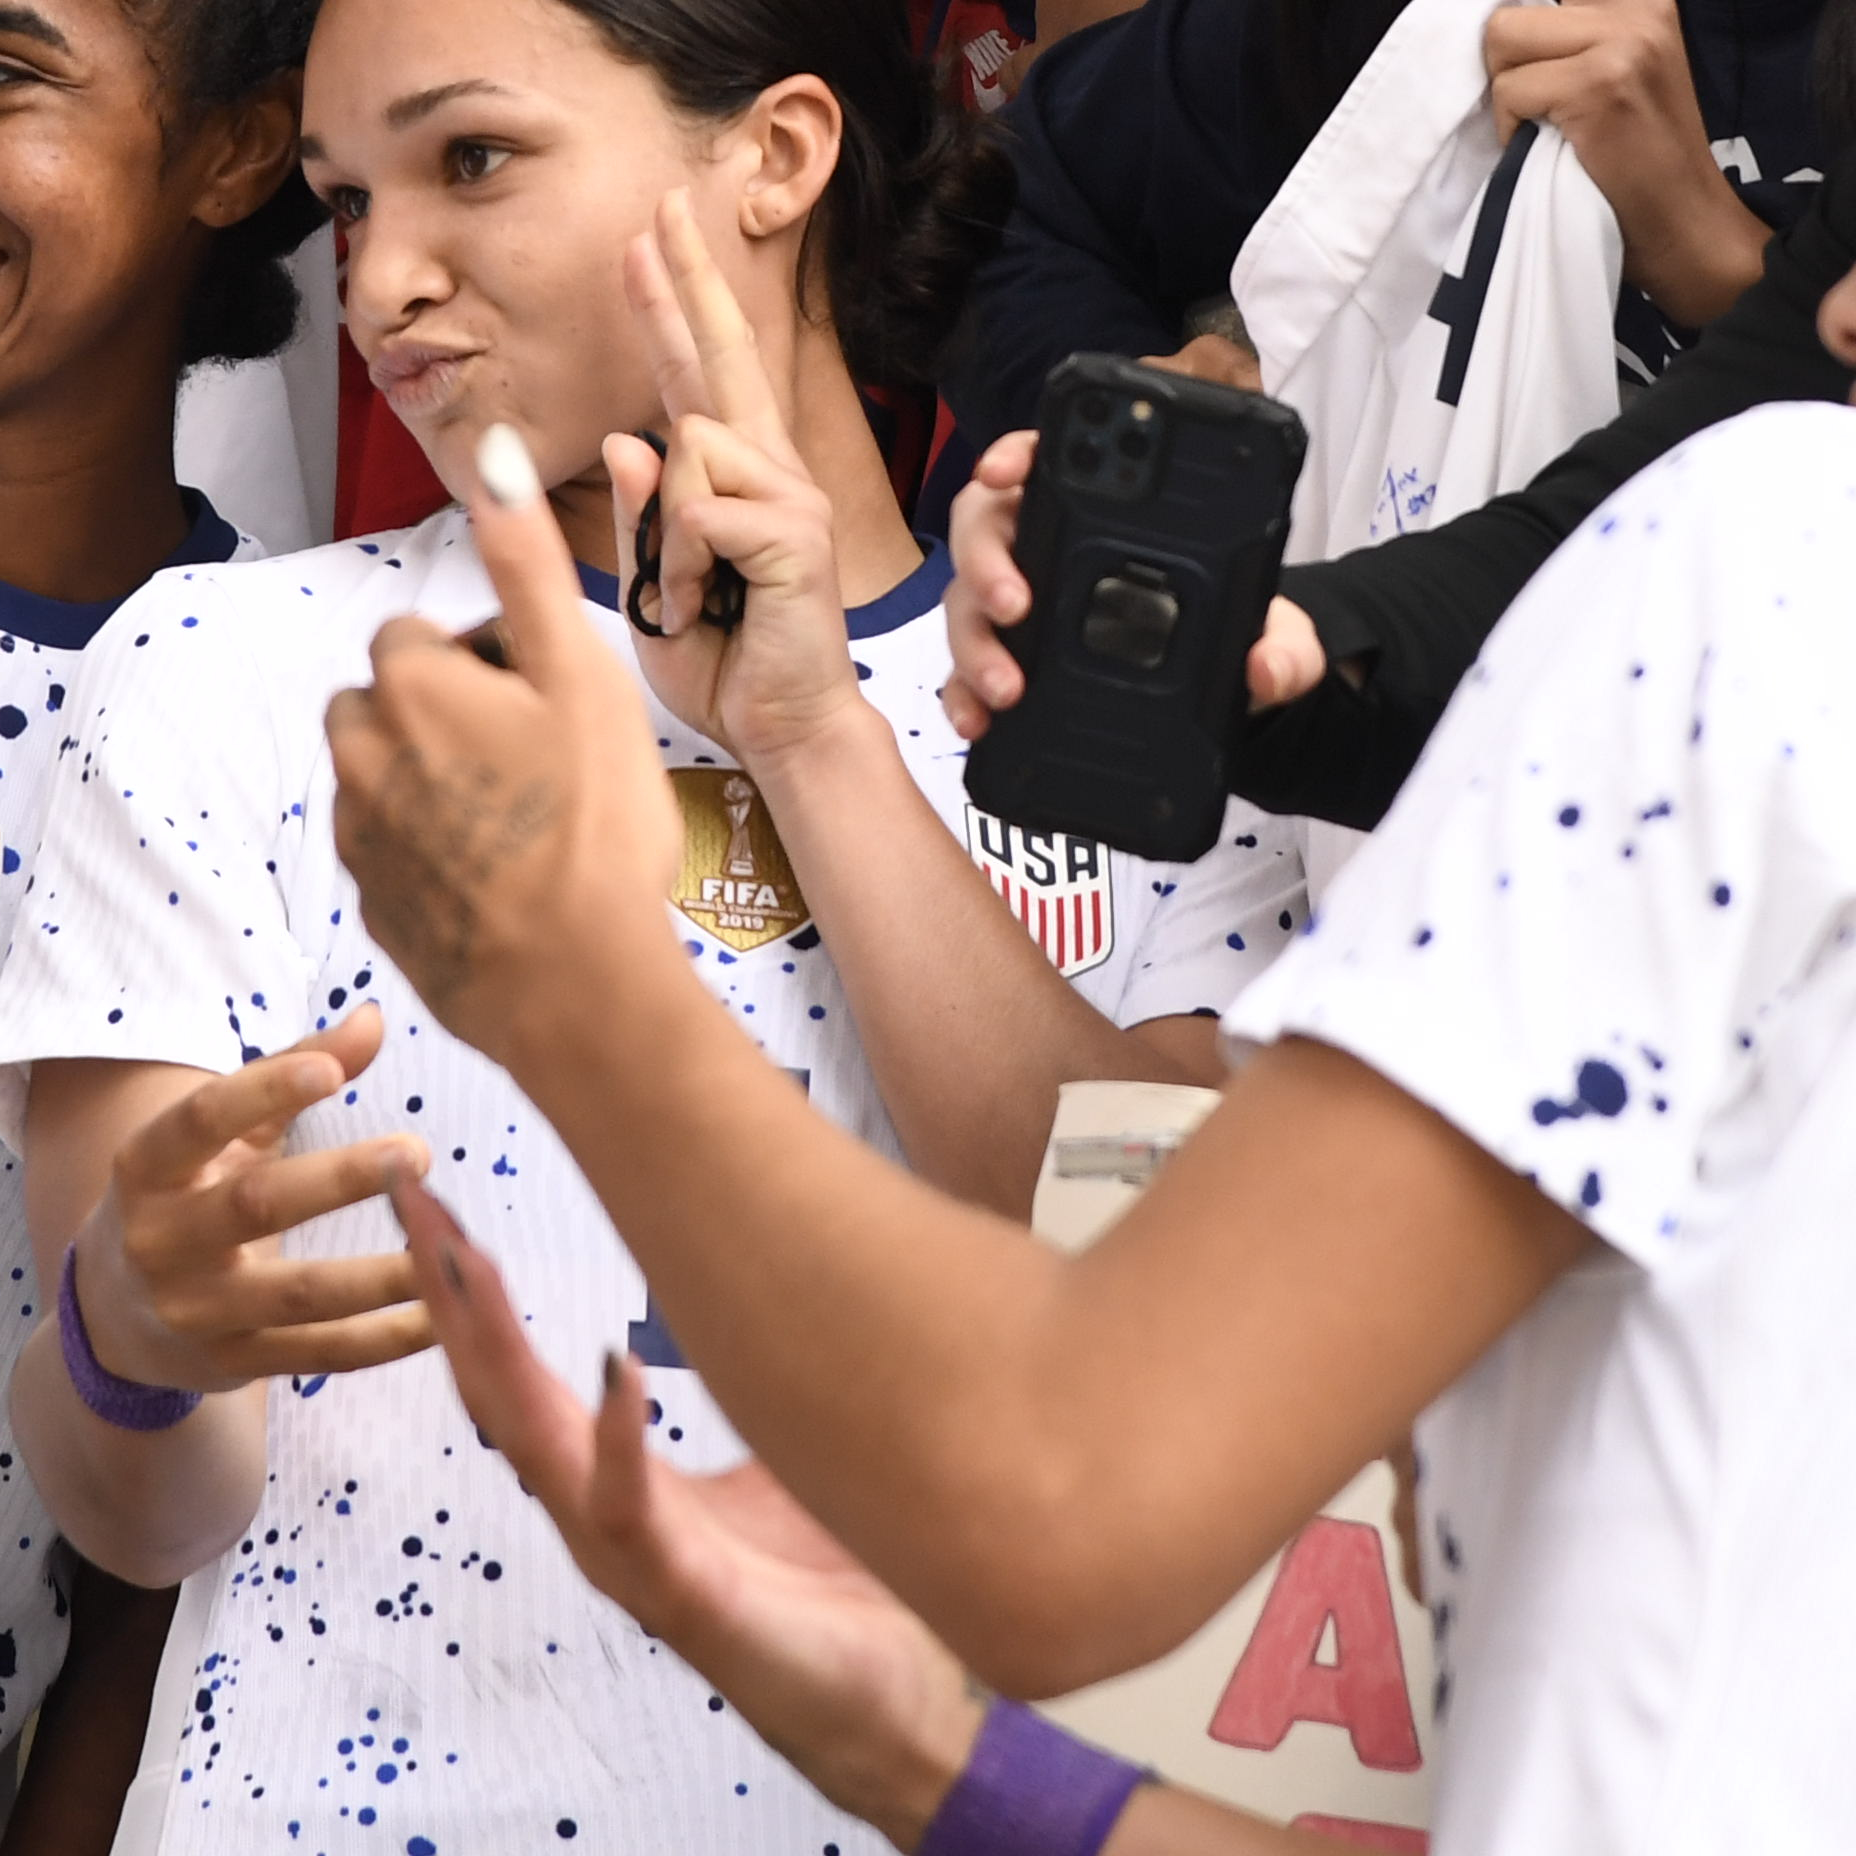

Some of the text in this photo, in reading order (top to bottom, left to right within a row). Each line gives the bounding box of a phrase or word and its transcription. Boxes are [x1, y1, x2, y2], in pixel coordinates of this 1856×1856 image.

[963, 30, 1017, 81] NIKE
[978, 816, 1100, 887] USA
[701, 878, 780, 908] FIFA
[717, 912, 766, 930] 2019
[1207, 1514, 1424, 1774] A
